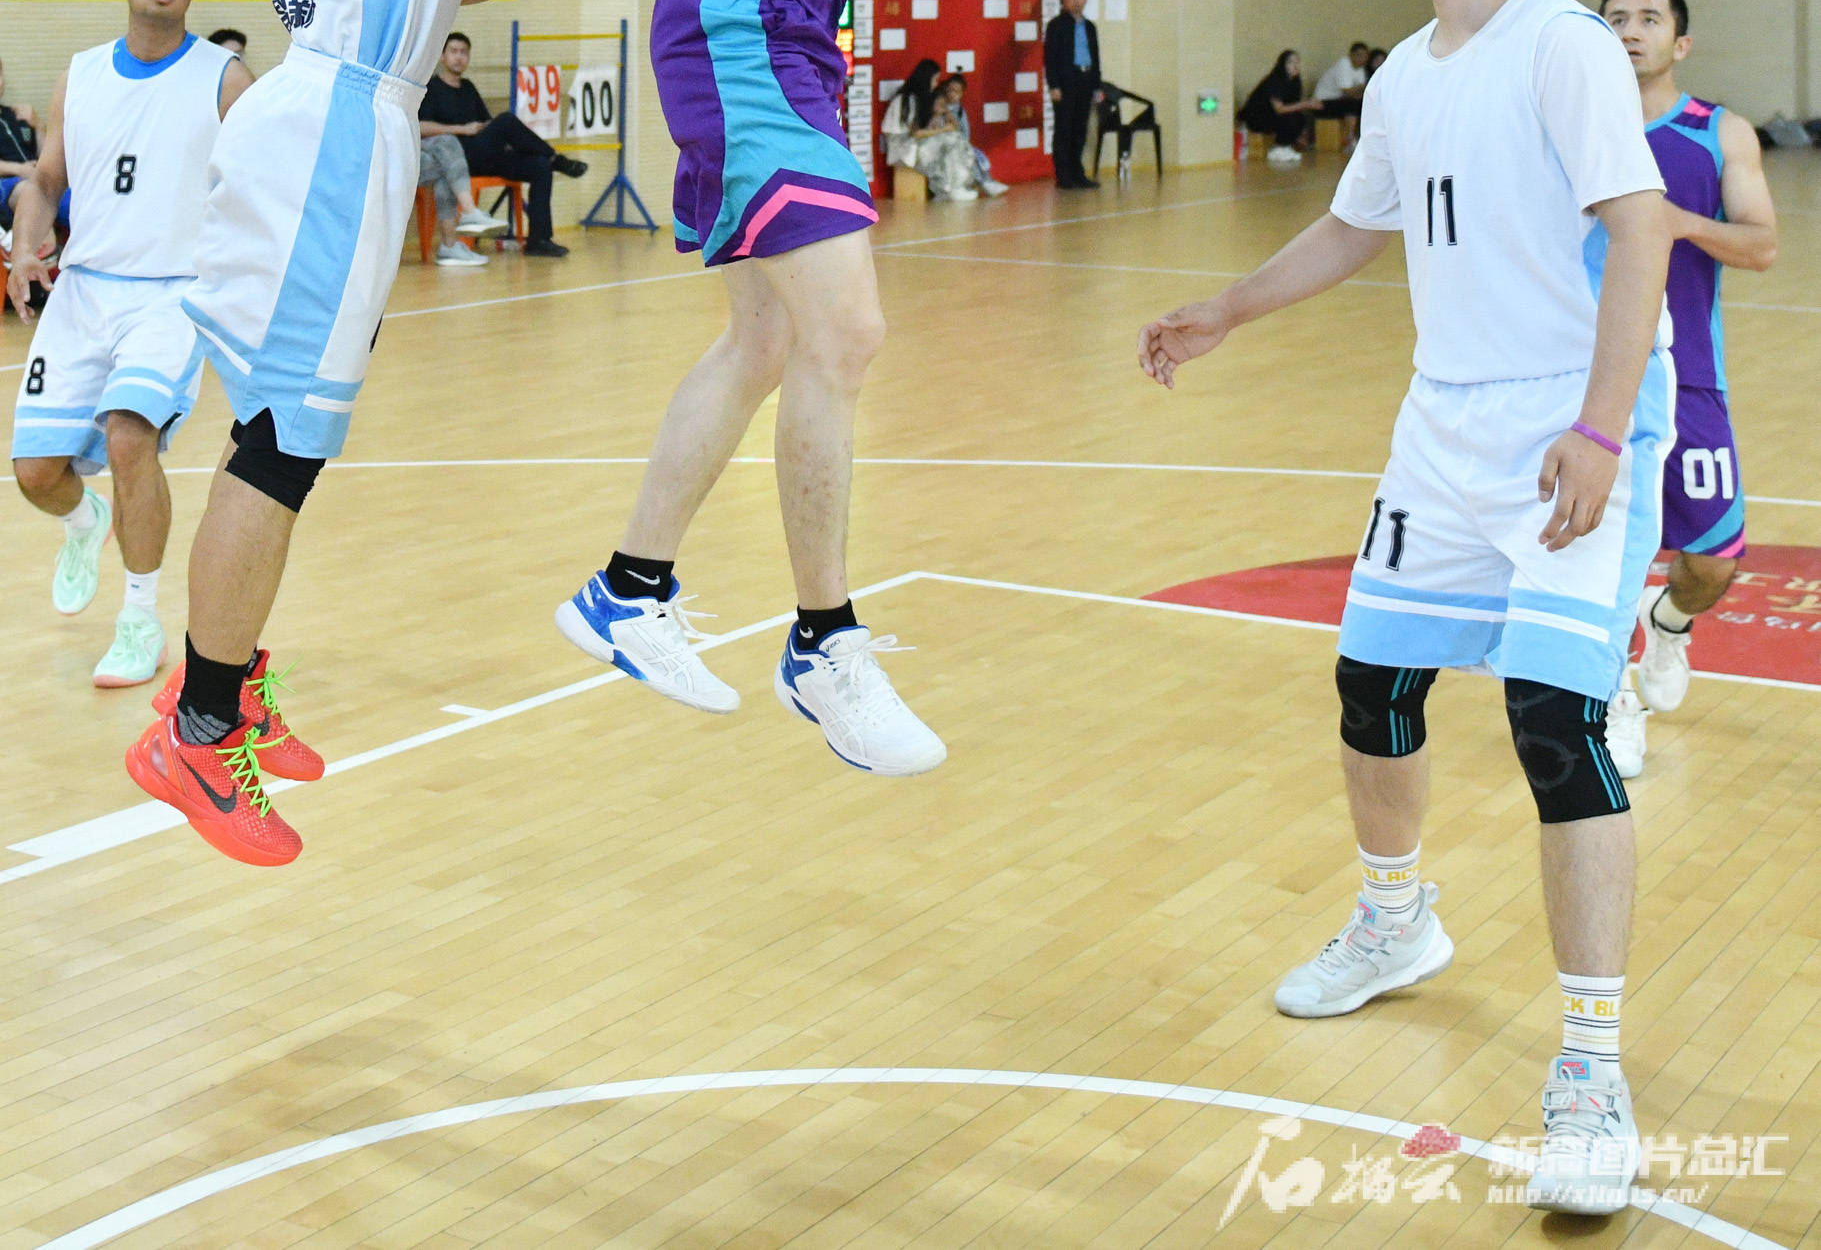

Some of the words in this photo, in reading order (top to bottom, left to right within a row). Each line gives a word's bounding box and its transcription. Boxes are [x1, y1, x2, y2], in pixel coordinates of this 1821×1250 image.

[114, 154, 136, 195] 8
[1426, 175, 1457, 246] 11
[26, 356, 45, 396] 8
[1682, 447, 1734, 500] 01
[1361, 497, 1409, 571] 11
